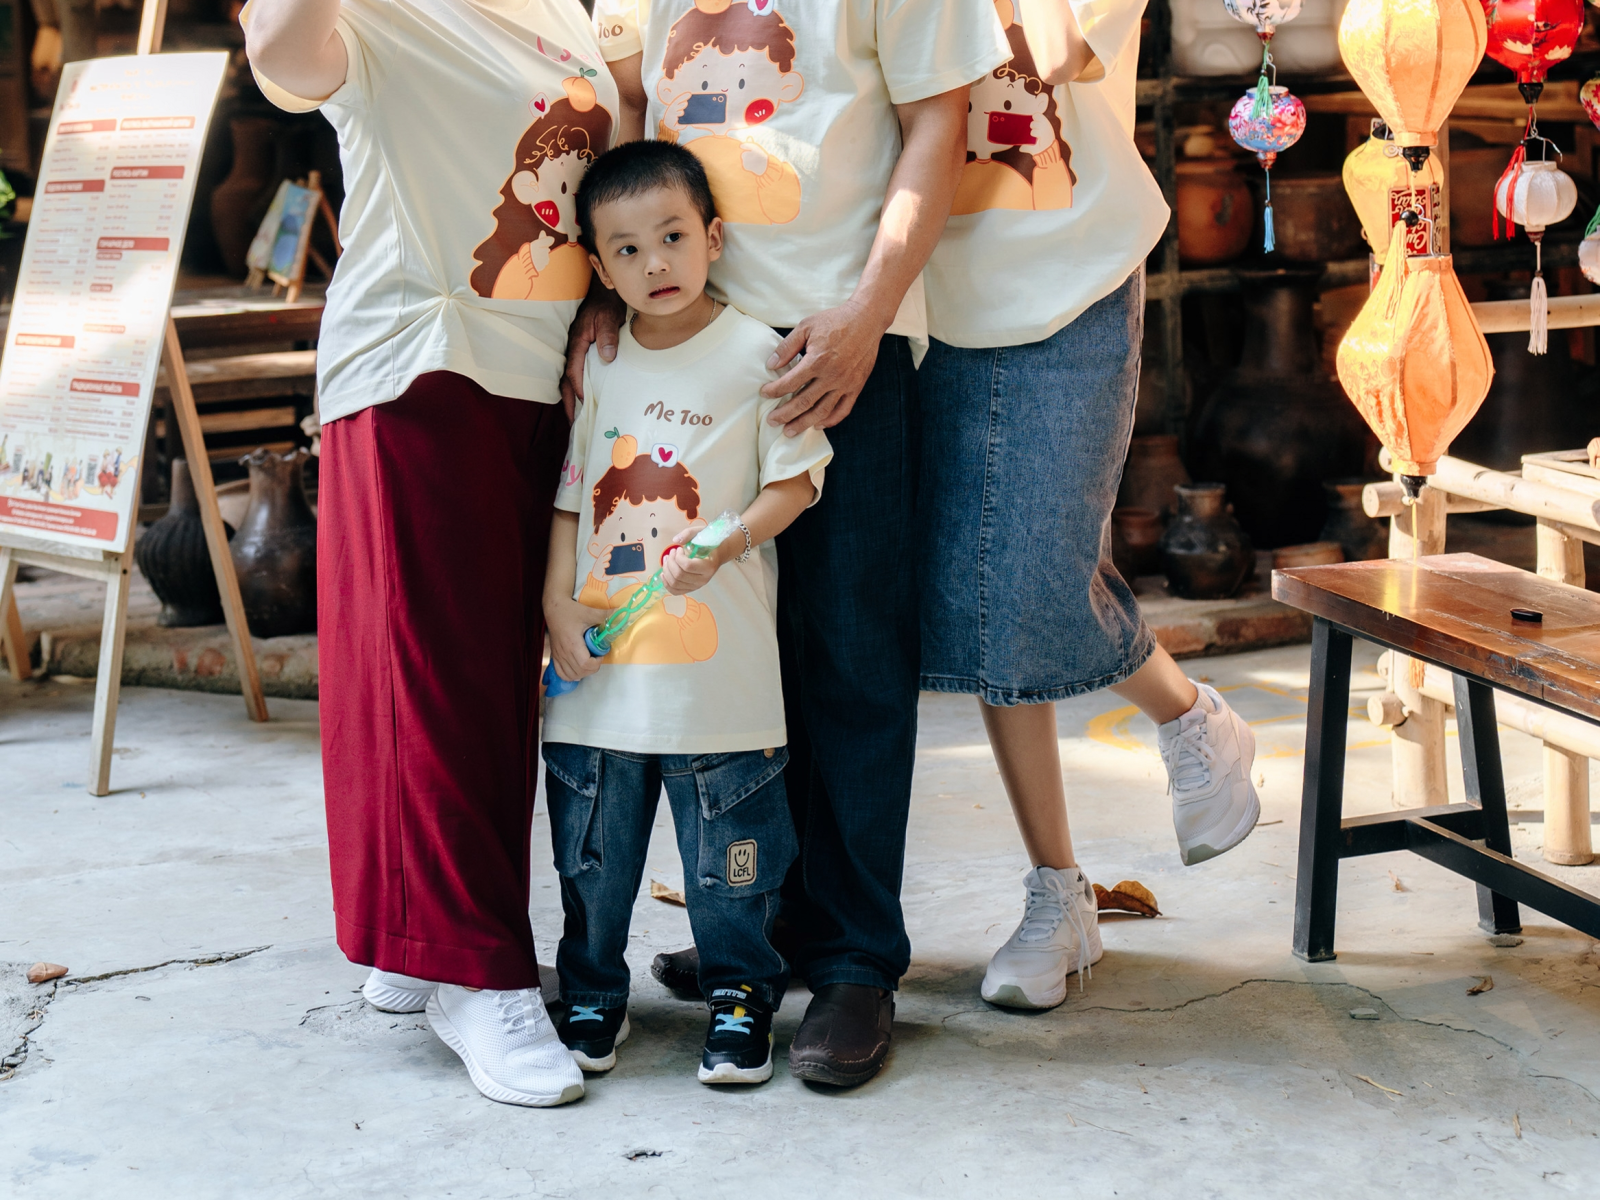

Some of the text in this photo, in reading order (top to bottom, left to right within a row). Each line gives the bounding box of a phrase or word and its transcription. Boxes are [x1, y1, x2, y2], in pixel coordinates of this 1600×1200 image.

[644, 400, 713, 426] Me Too
[733, 867, 751, 877] LCFL
